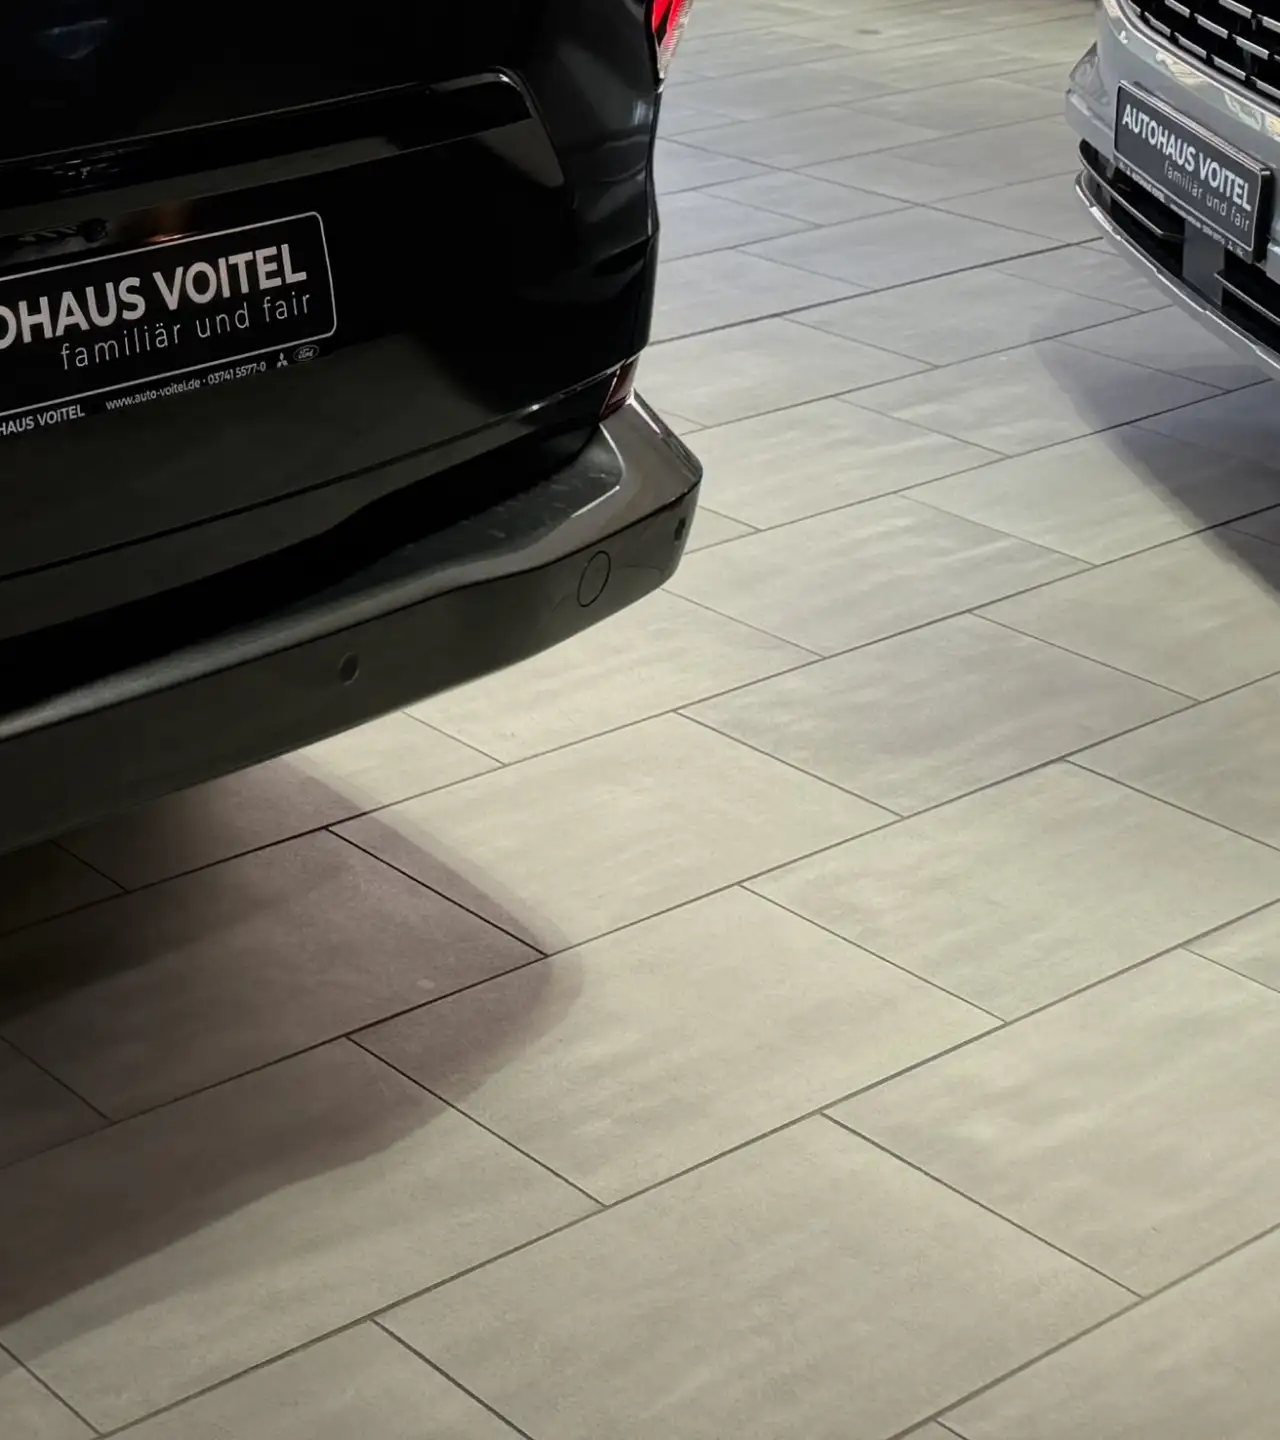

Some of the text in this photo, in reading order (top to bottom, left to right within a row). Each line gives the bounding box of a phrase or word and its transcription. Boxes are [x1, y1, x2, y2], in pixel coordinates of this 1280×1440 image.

[1122, 103, 1196, 172] AUTOHAUS
[1198, 152, 1252, 211] VOITEL
[1164, 160, 1203, 198] familiär
[1206, 193, 1227, 217] und
[1230, 208, 1250, 231] fair
[153, 244, 307, 312] VOITEL
[61, 291, 311, 370] familiär und fair
[37, 404, 85, 426] VOITEL
[105, 379, 201, 411] www.auto-voitel.de
[207, 368, 234, 386] 03741
[235, 361, 267, 379] 5577-0
